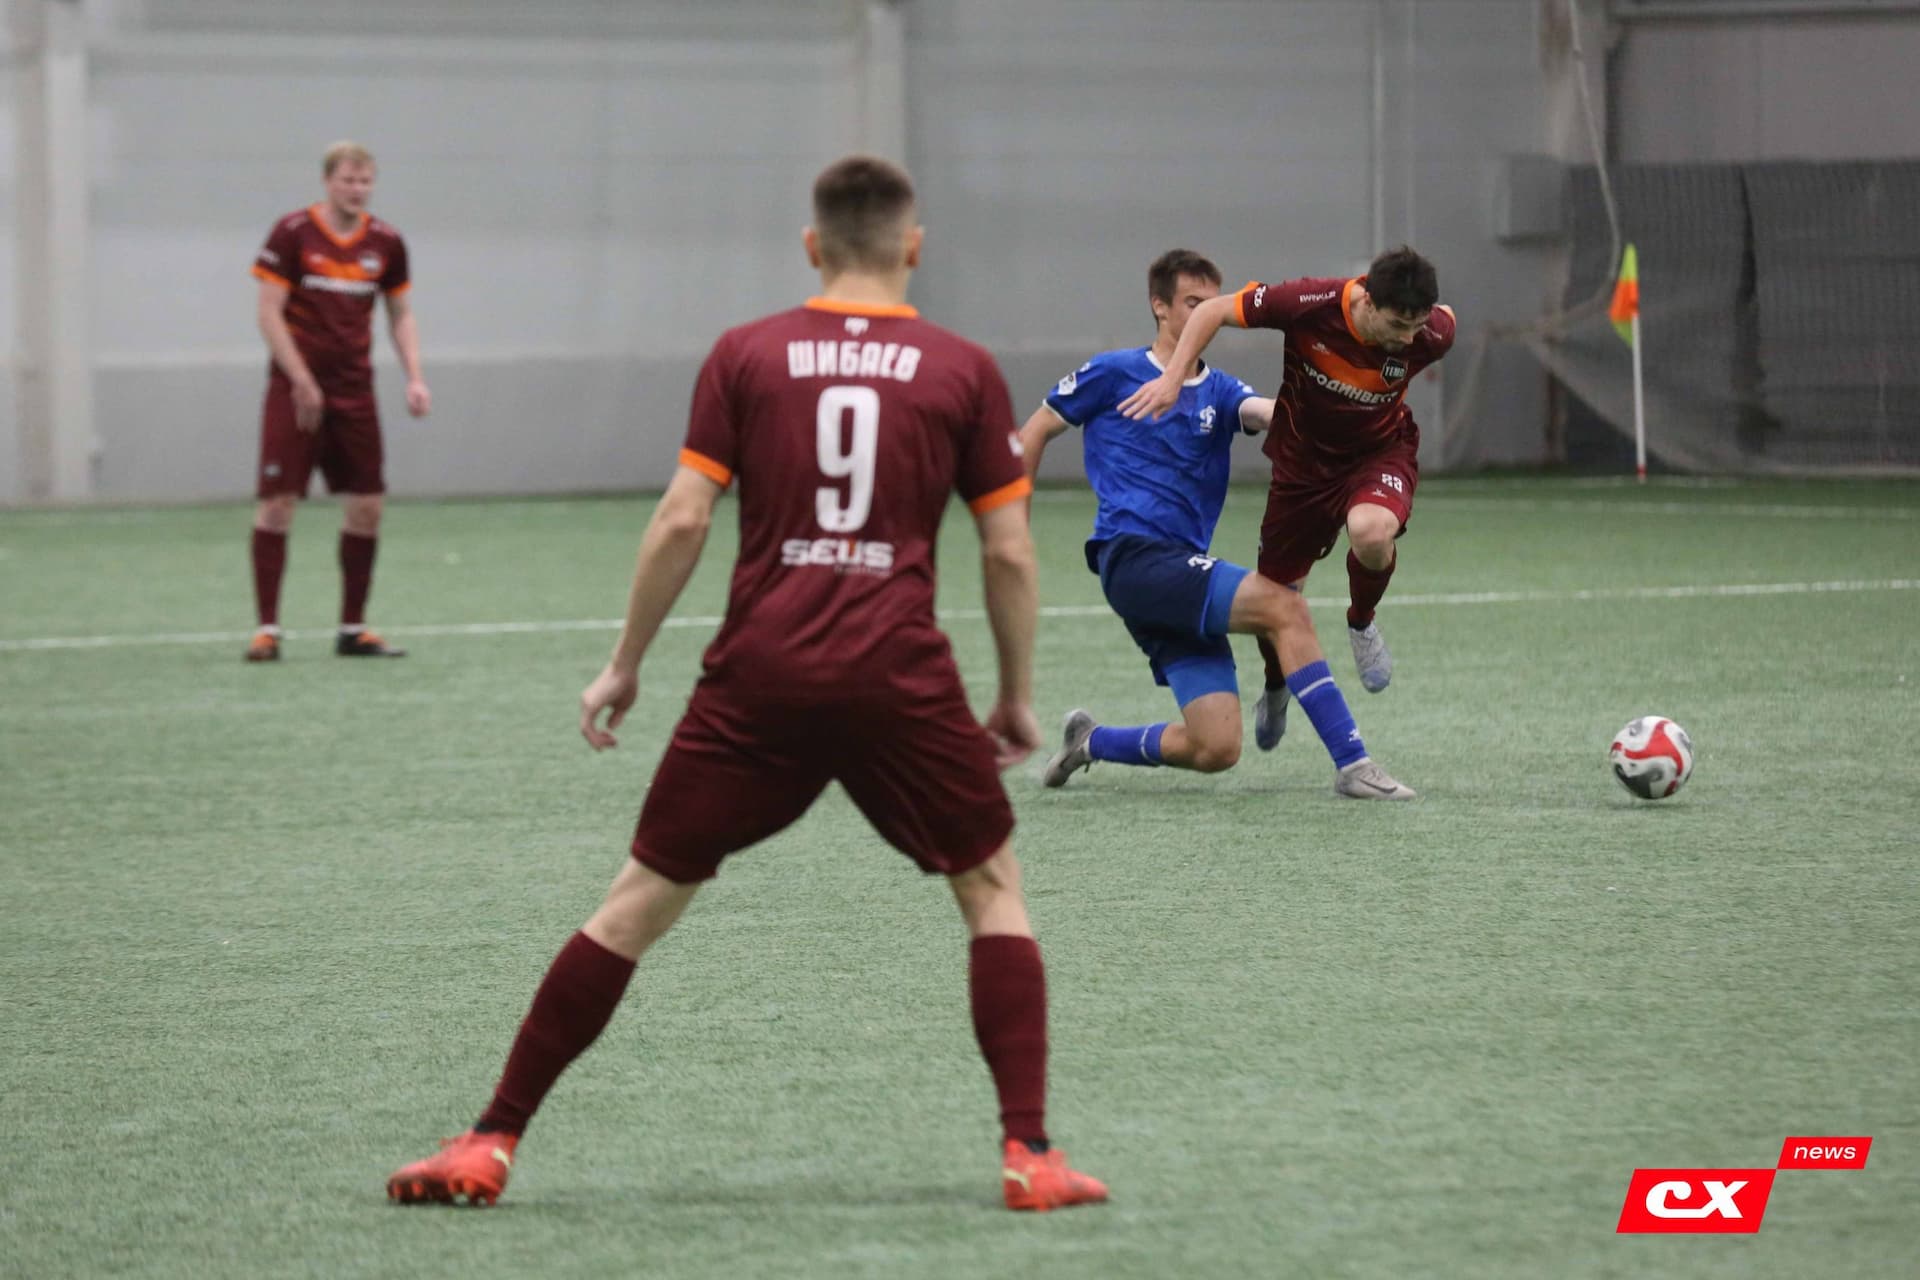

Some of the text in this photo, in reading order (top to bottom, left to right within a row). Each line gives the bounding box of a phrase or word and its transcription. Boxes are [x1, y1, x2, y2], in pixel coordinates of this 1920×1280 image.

[787, 340, 922, 382] ШИБАЕВ
[816, 384, 880, 533] 9
[781, 537, 894, 568] SEUS
